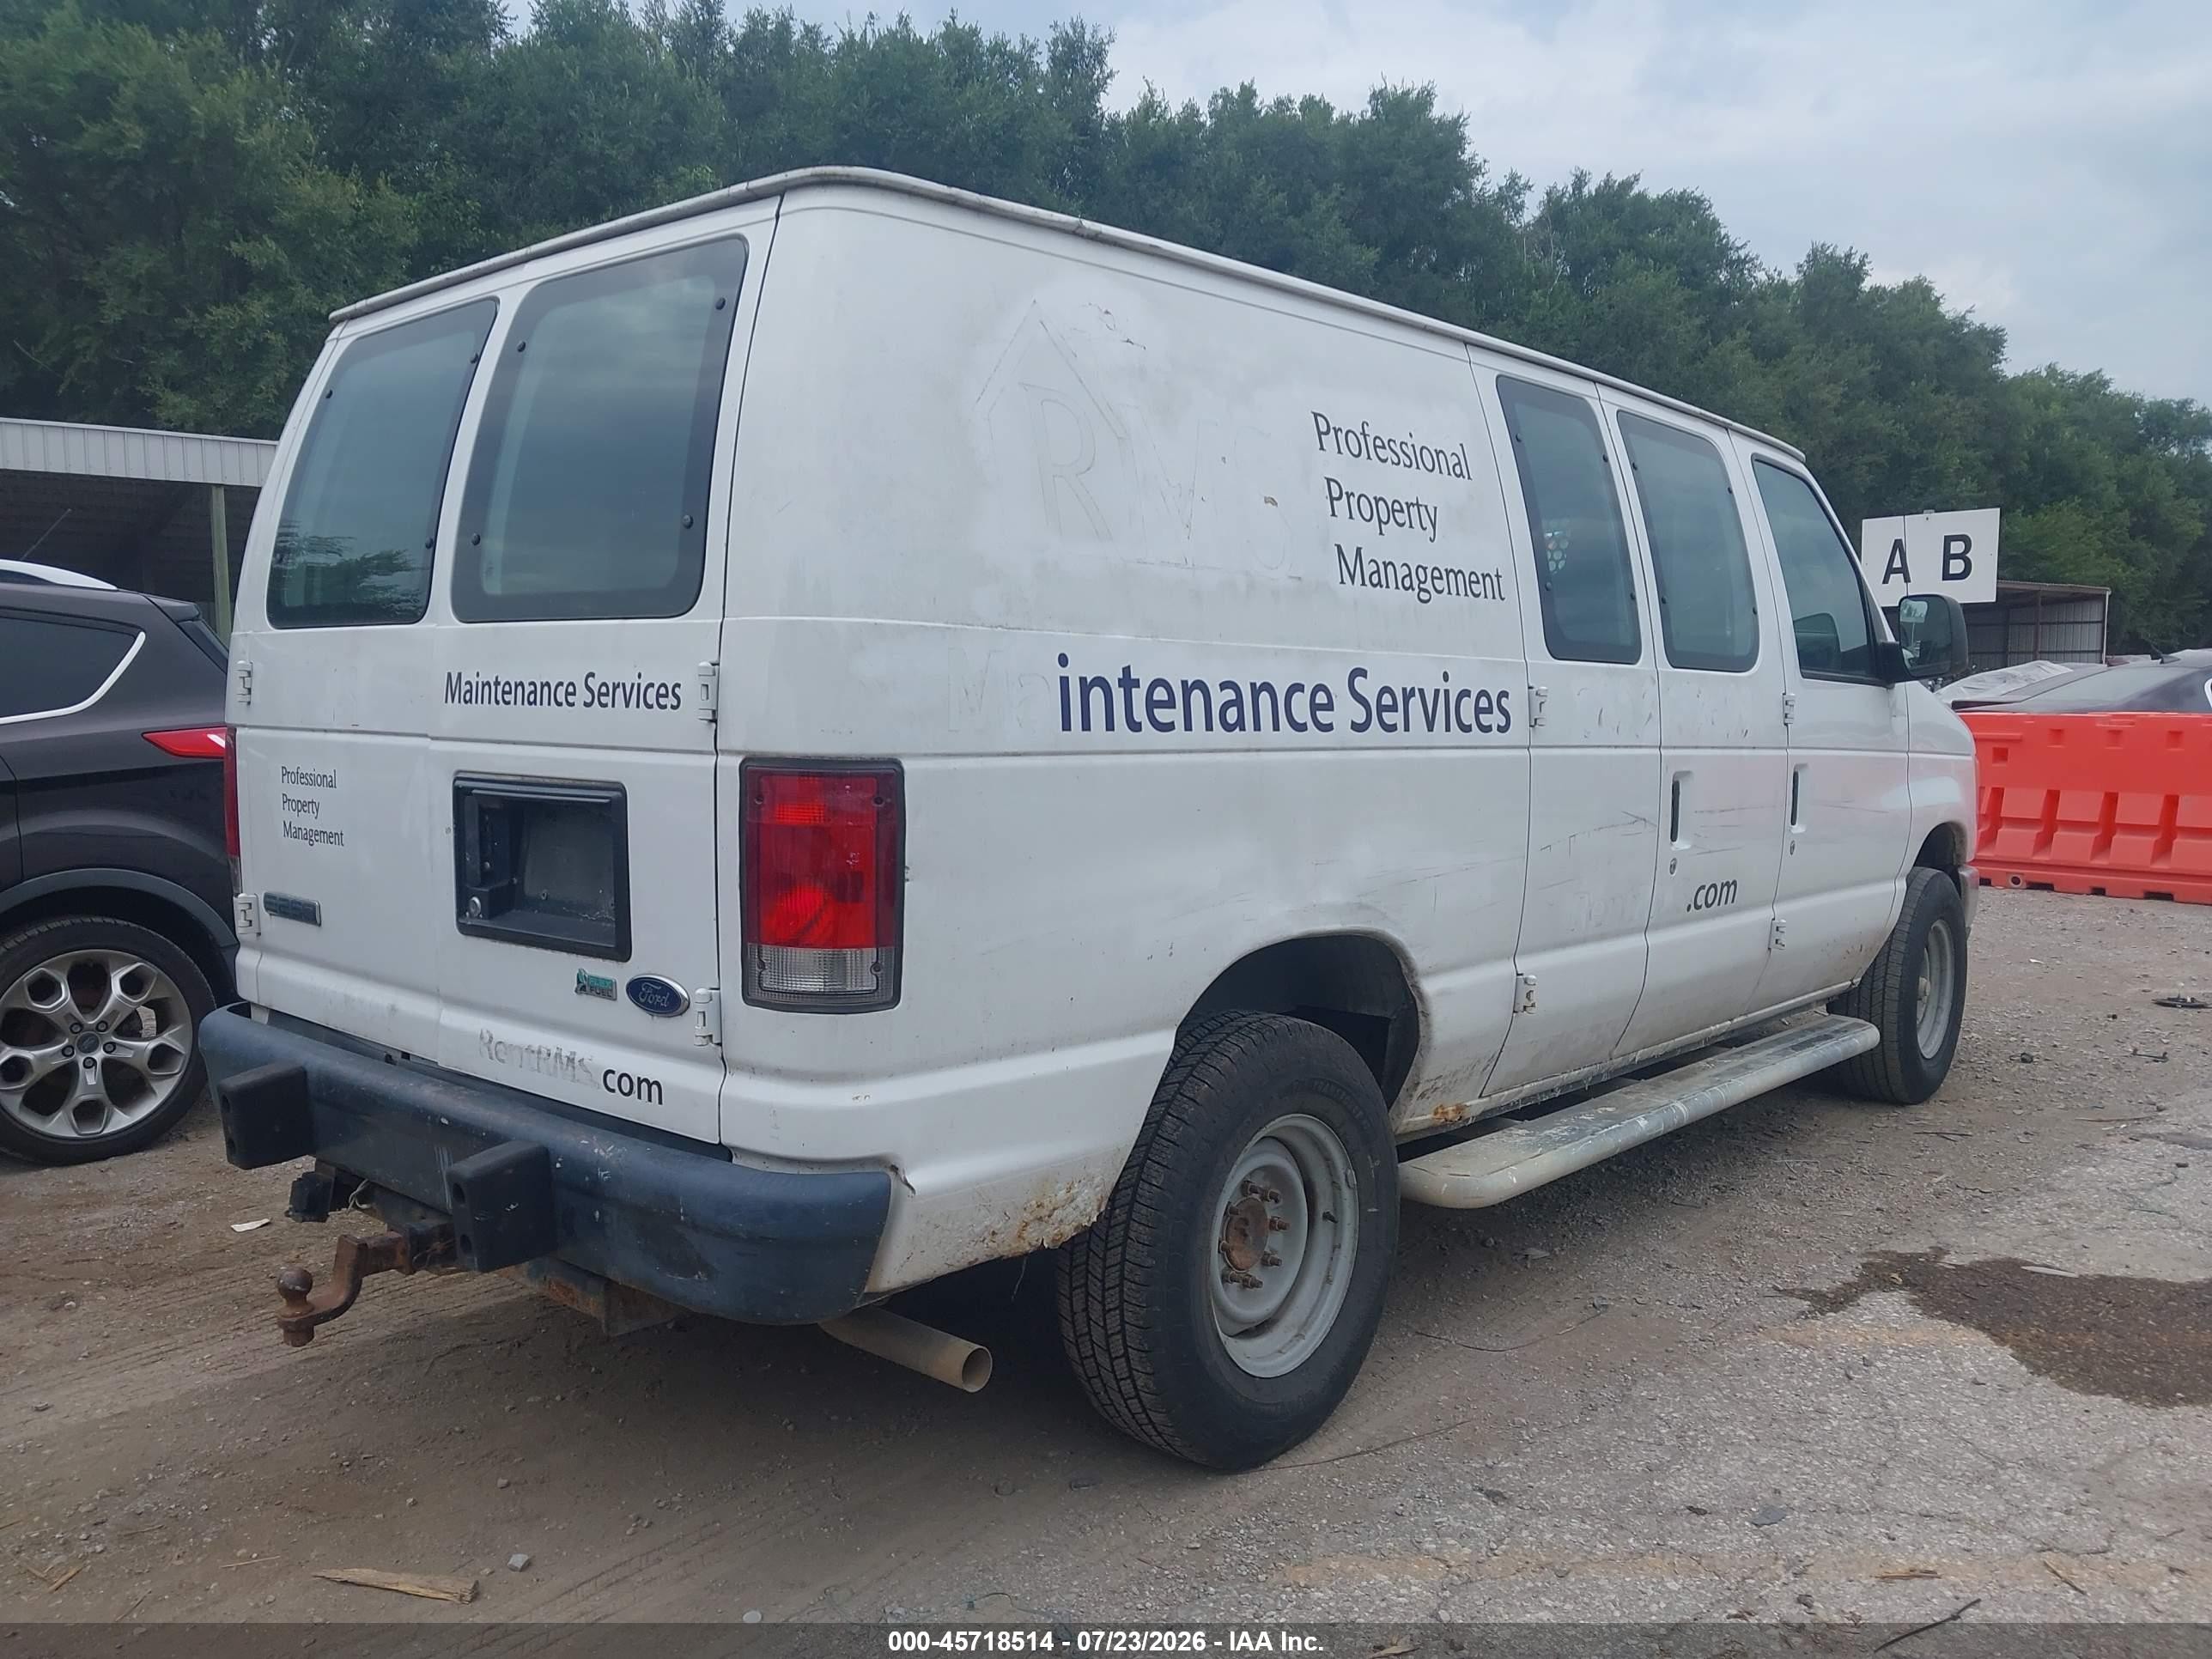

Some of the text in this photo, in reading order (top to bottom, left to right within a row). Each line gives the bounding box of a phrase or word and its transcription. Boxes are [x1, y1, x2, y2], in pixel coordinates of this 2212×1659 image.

[1310, 410, 1473, 481] Professional
[1323, 476, 1438, 543] Property
[1334, 543, 1506, 604] Management
[1881, 538, 1911, 585] A
[1942, 533, 1972, 581] B
[444, 671, 682, 711] Maintenance Services
[1348, 666, 1511, 734] Services
[281, 765, 337, 789] Professional
[281, 793, 320, 819] Property
[283, 819, 344, 847] Management
[1686, 878, 1738, 913] .com
